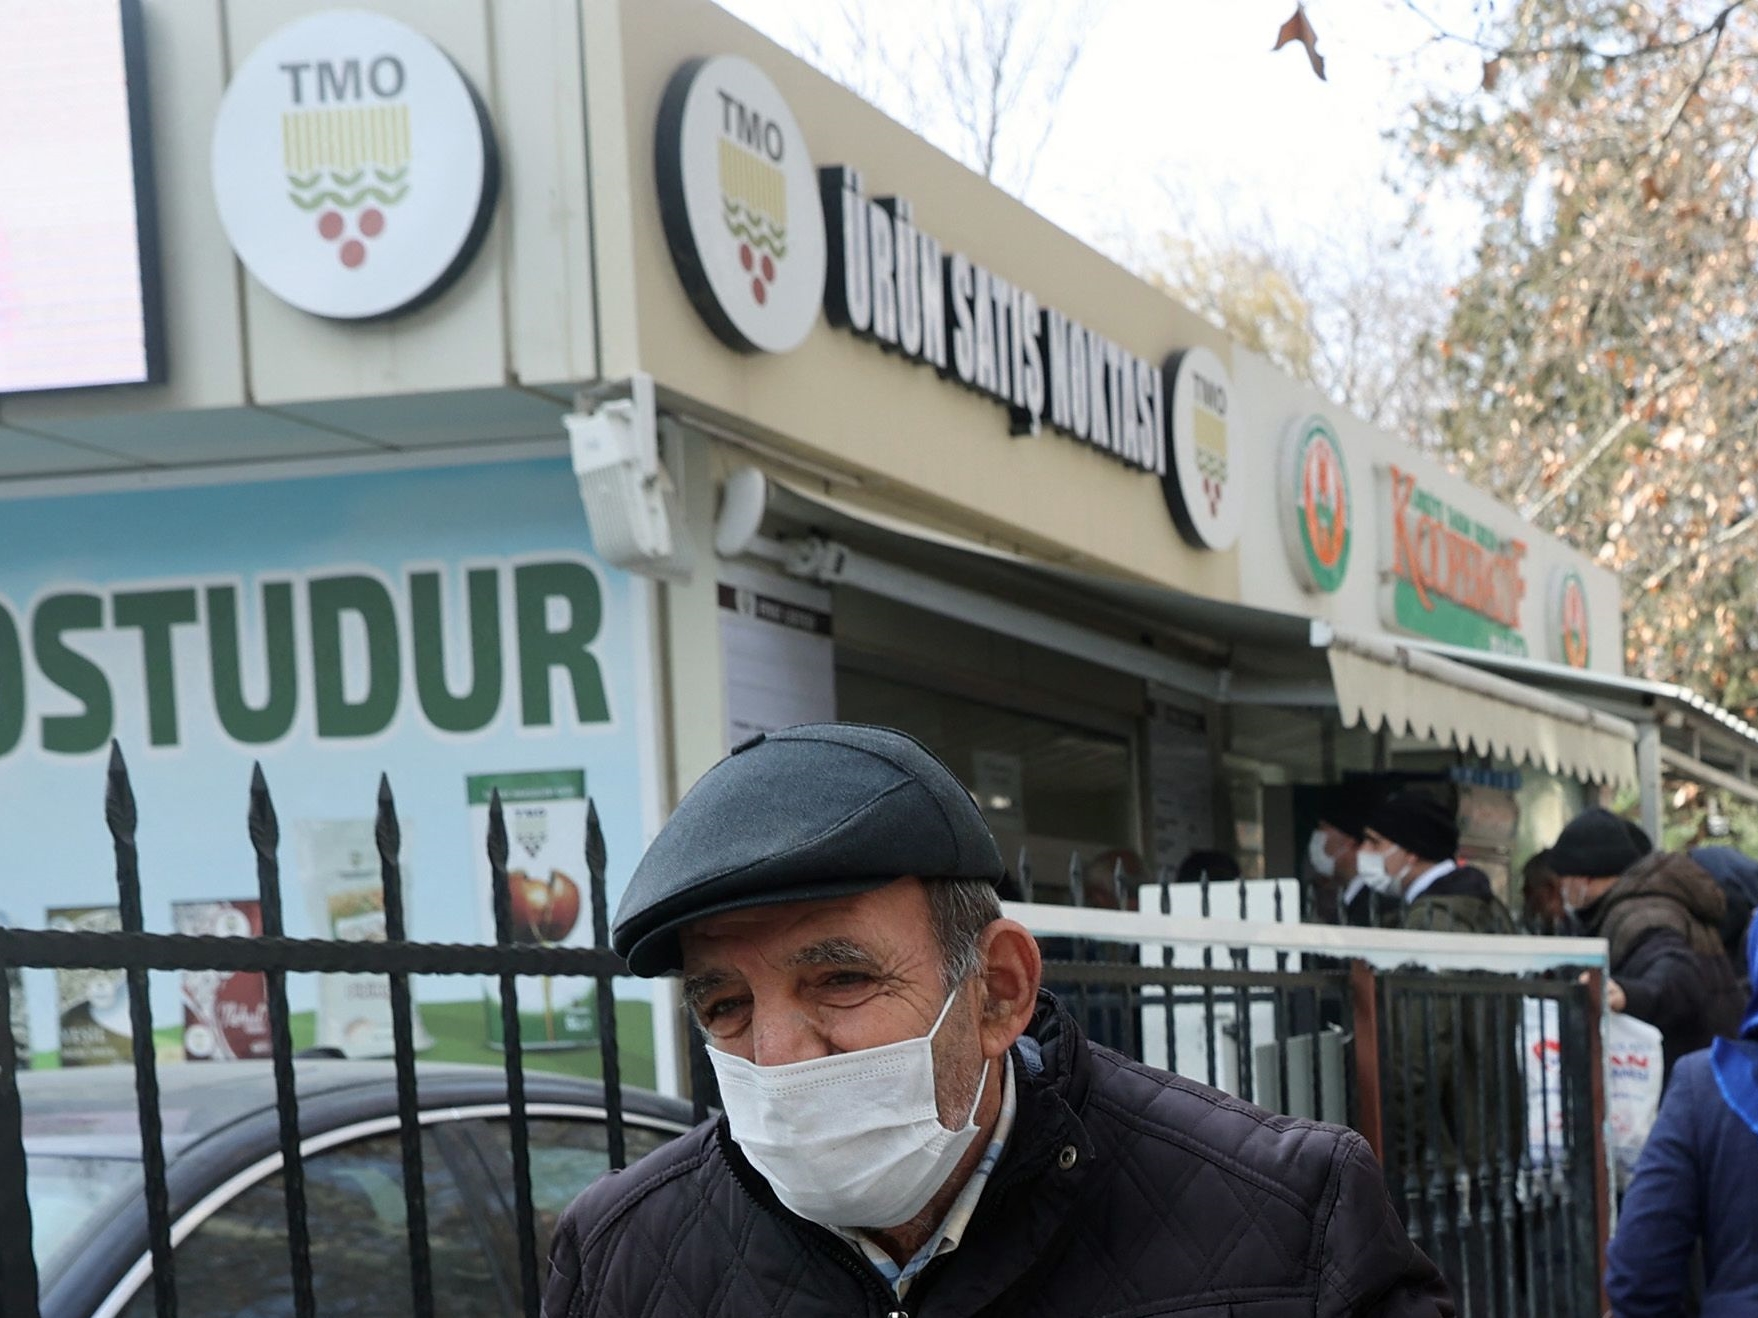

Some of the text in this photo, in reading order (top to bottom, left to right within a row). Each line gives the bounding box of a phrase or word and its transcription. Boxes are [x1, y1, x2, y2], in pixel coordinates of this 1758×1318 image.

[279, 56, 406, 104] TMO
[717, 88, 784, 162] TMO
[842, 165, 1167, 477] ÜRÜN SATIŞ NOKTASI
[1192, 369, 1228, 417] TMO
